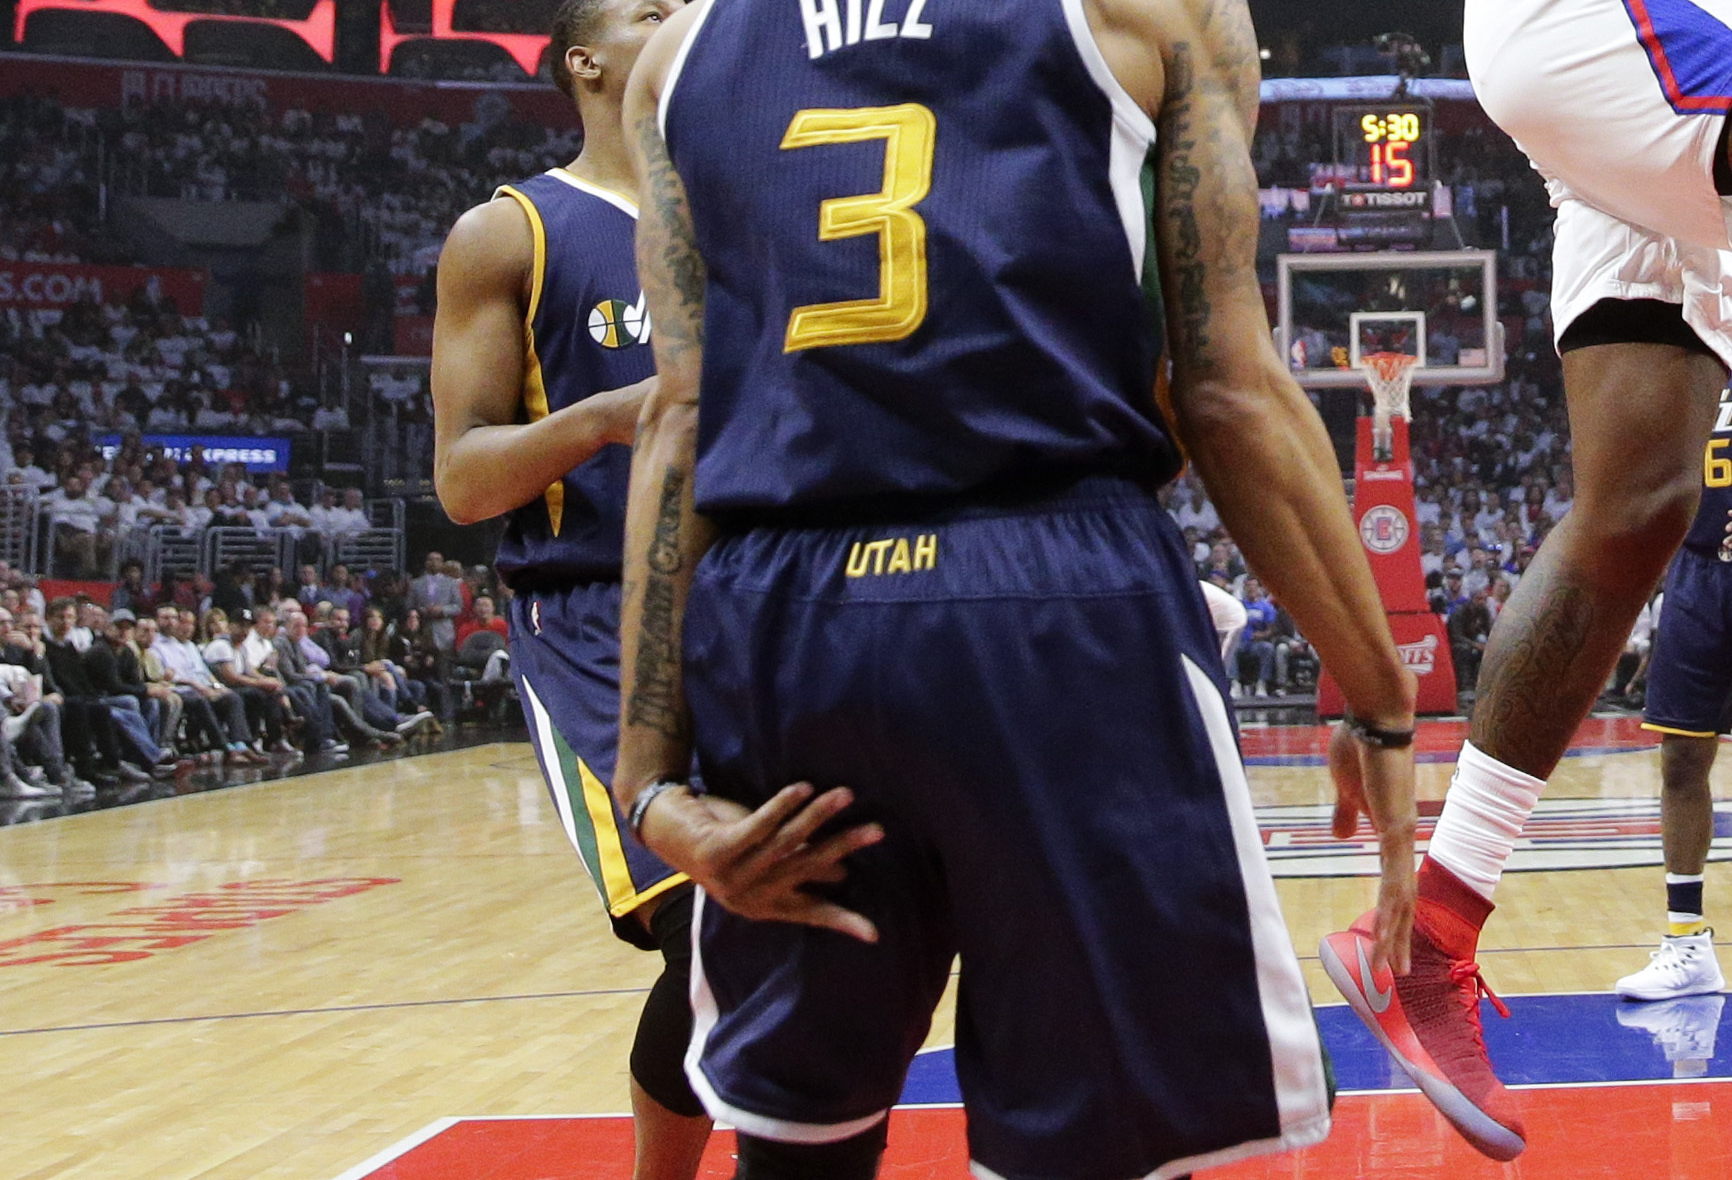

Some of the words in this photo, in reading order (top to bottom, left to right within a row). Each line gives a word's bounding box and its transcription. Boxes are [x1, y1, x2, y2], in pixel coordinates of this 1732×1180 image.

[1361, 113, 1419, 143] 5:30
[1370, 141, 1415, 187] 15
[1366, 191, 1427, 206] TISSOT
[779, 102, 936, 354] 3
[845, 533, 938, 578] UTAH
